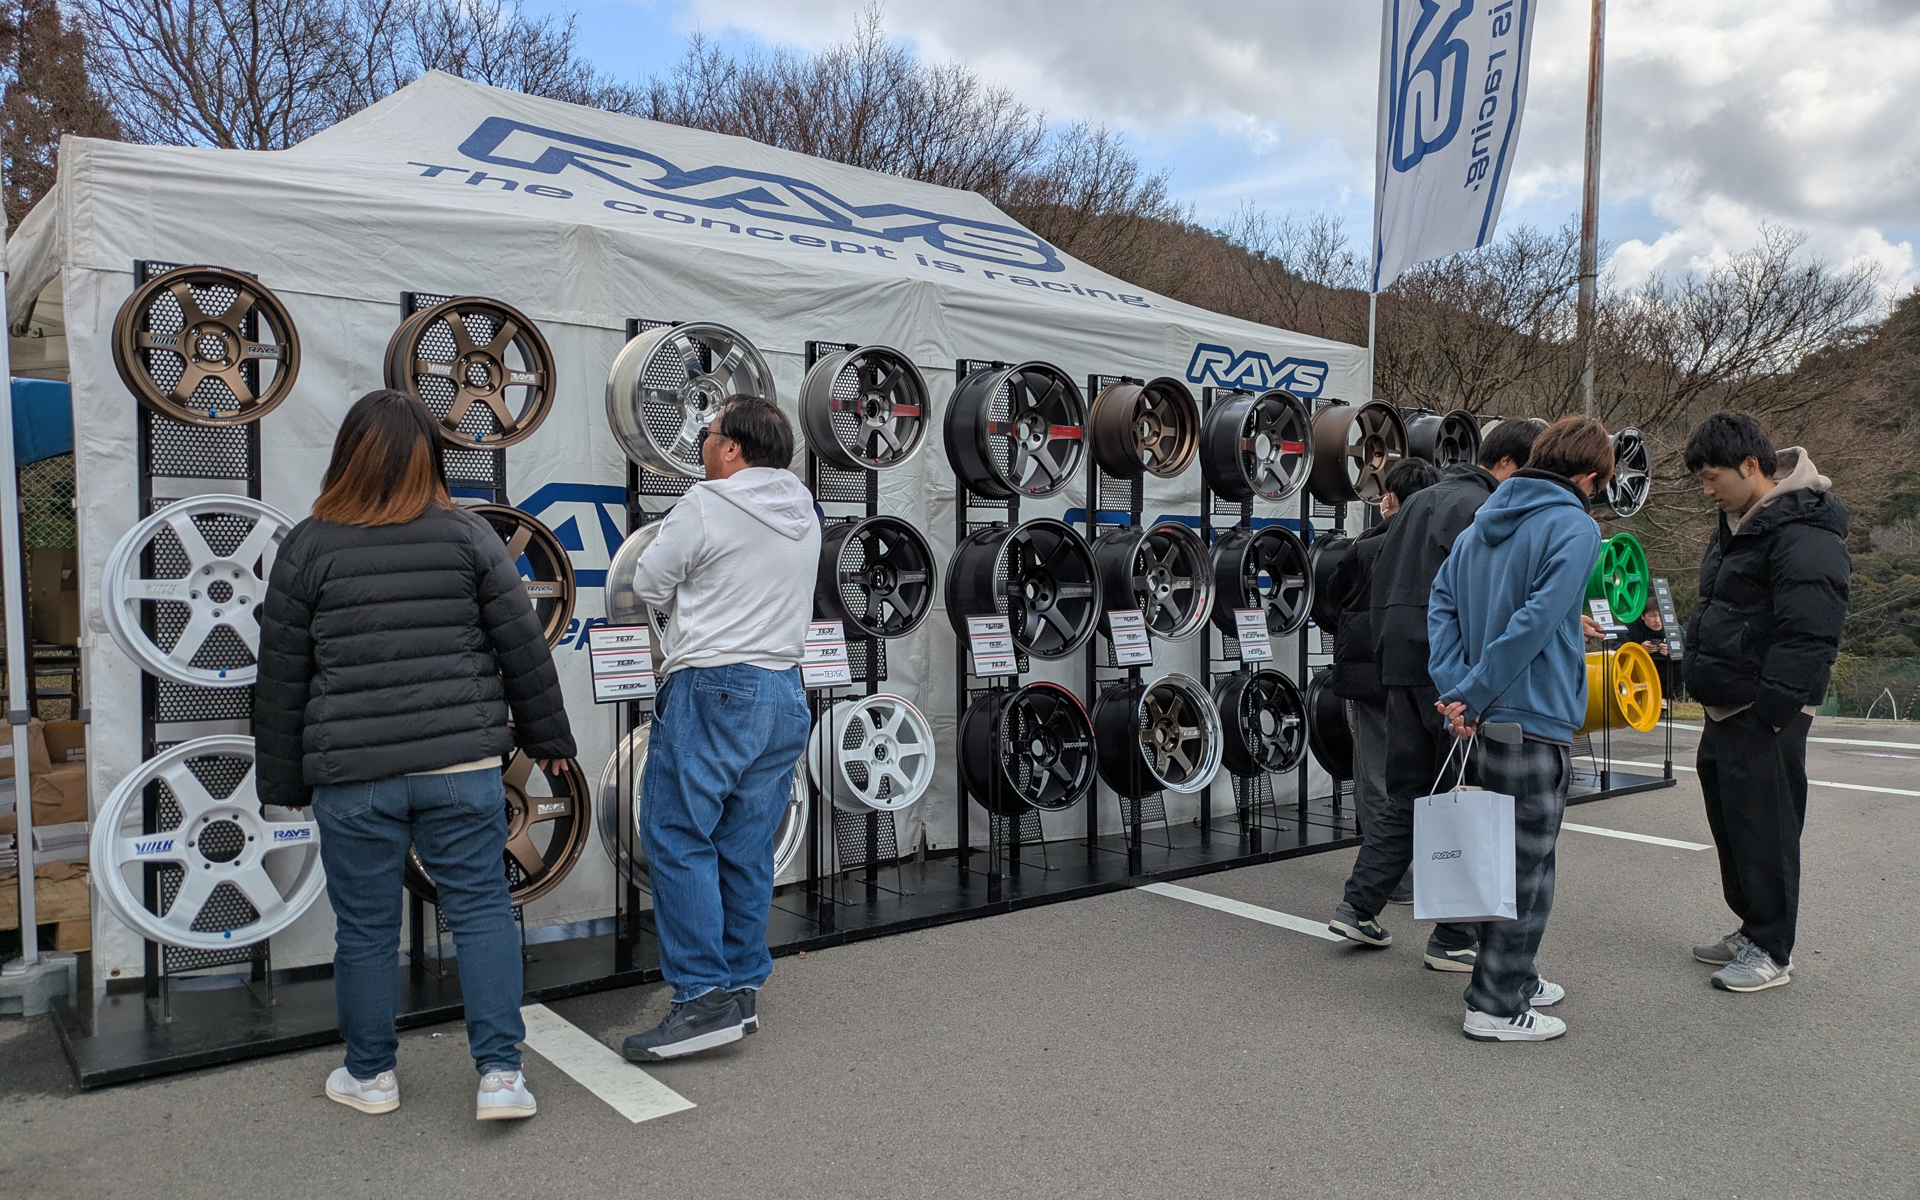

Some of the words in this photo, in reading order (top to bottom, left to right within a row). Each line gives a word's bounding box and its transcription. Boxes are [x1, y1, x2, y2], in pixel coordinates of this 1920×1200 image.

[458, 116, 1065, 272] RAYS
[407, 161, 574, 200] The
[603, 199, 898, 261] concept
[915, 253, 966, 274] is
[983, 268, 1162, 308] racing.
[248, 346, 279, 354] RAYS
[1186, 343, 1330, 398] RAYS
[273, 828, 311, 839] RAYS
[1432, 850, 1462, 860] RAYS
